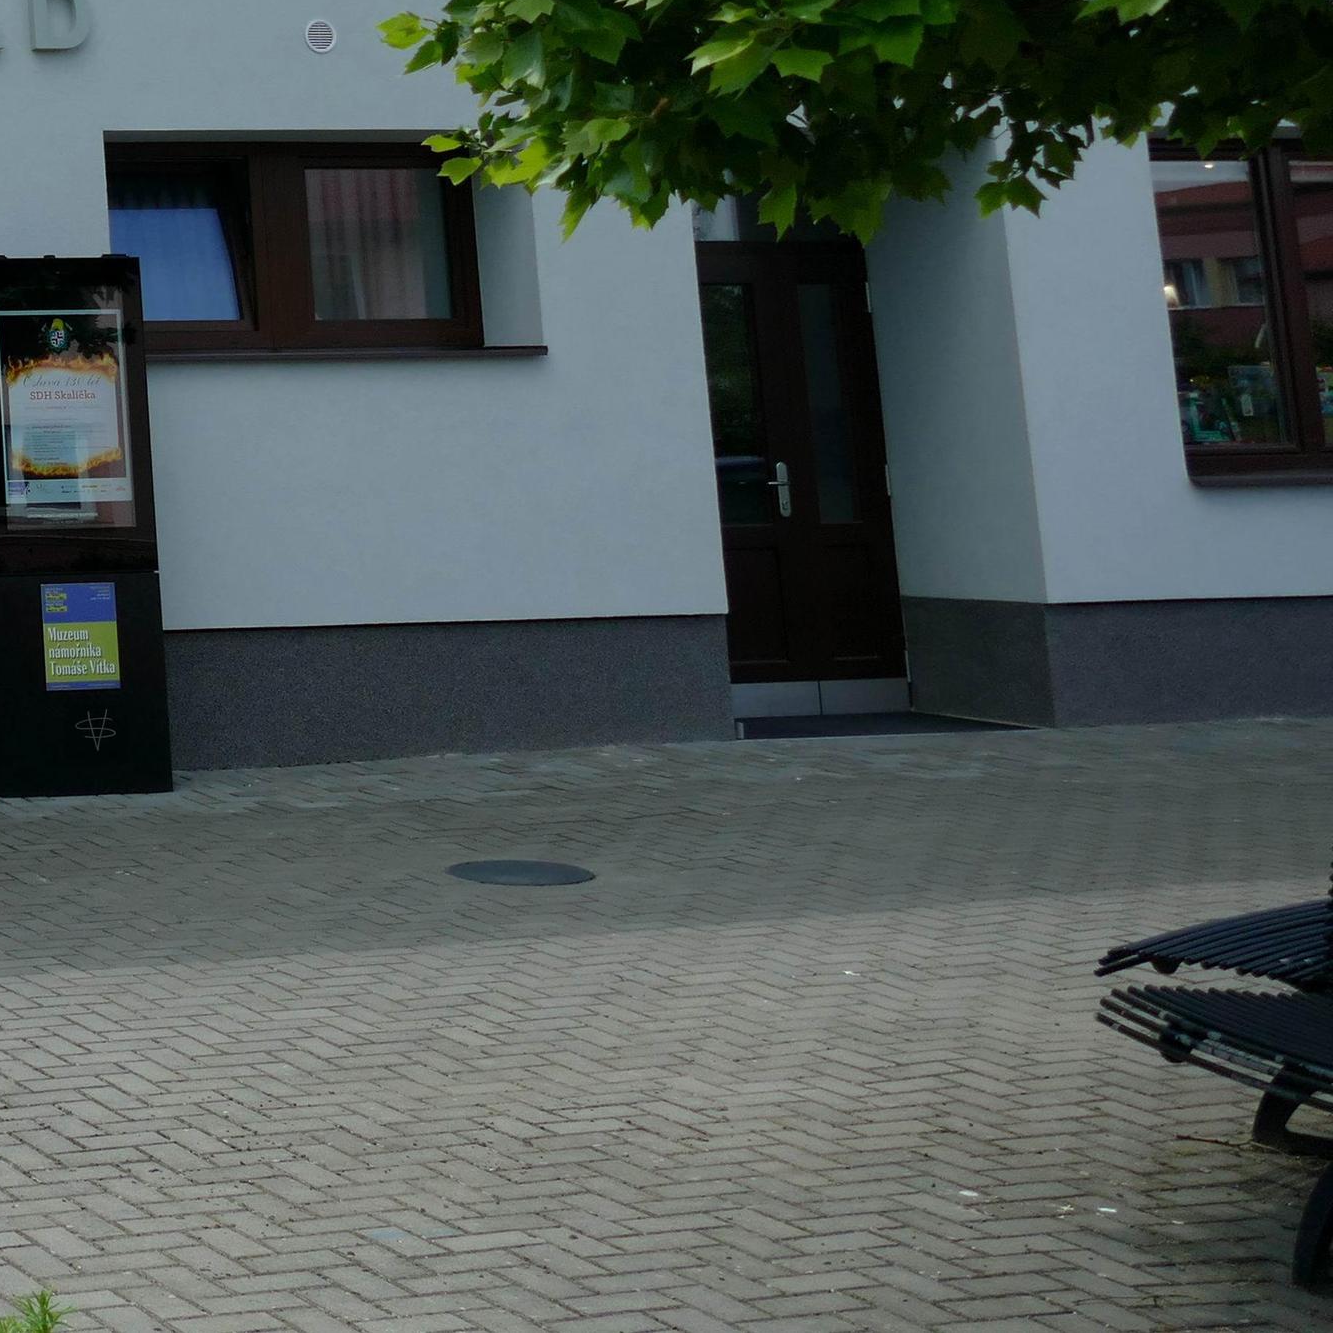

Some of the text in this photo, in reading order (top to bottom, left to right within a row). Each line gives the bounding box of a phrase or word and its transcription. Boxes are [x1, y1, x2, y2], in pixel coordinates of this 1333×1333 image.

[30, 391, 52, 400] SDH
[47, 627, 89, 642] Muzeum
[49, 661, 88, 676] Tomáše
